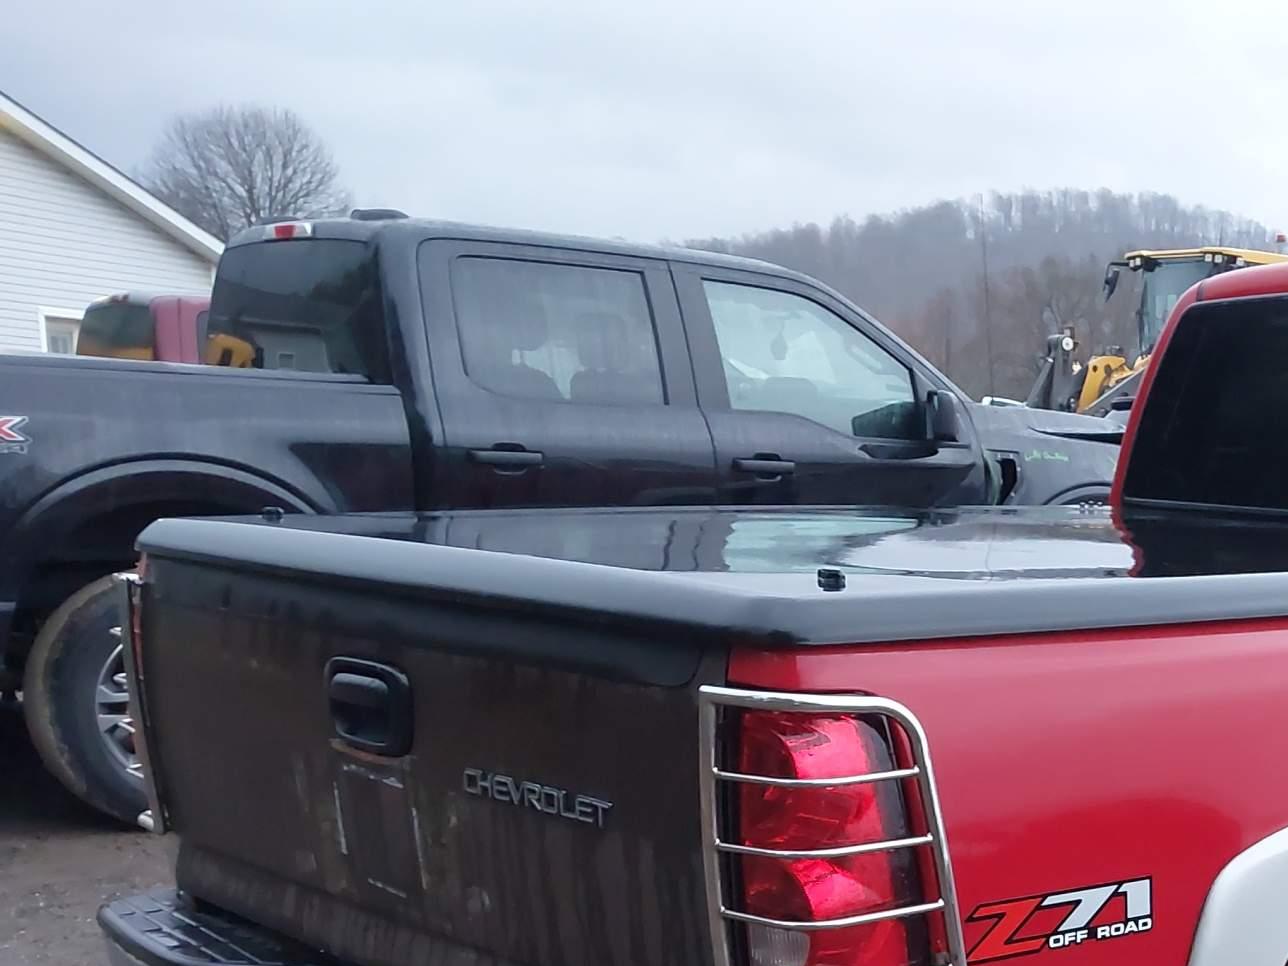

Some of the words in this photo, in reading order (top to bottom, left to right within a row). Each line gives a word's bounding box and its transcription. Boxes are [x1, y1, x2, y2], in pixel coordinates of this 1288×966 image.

[463, 768, 613, 827] CHEVROLET
[966, 876, 1152, 964] Z71
[1048, 929, 1089, 949] OFF
[1096, 917, 1152, 939] ROAD
